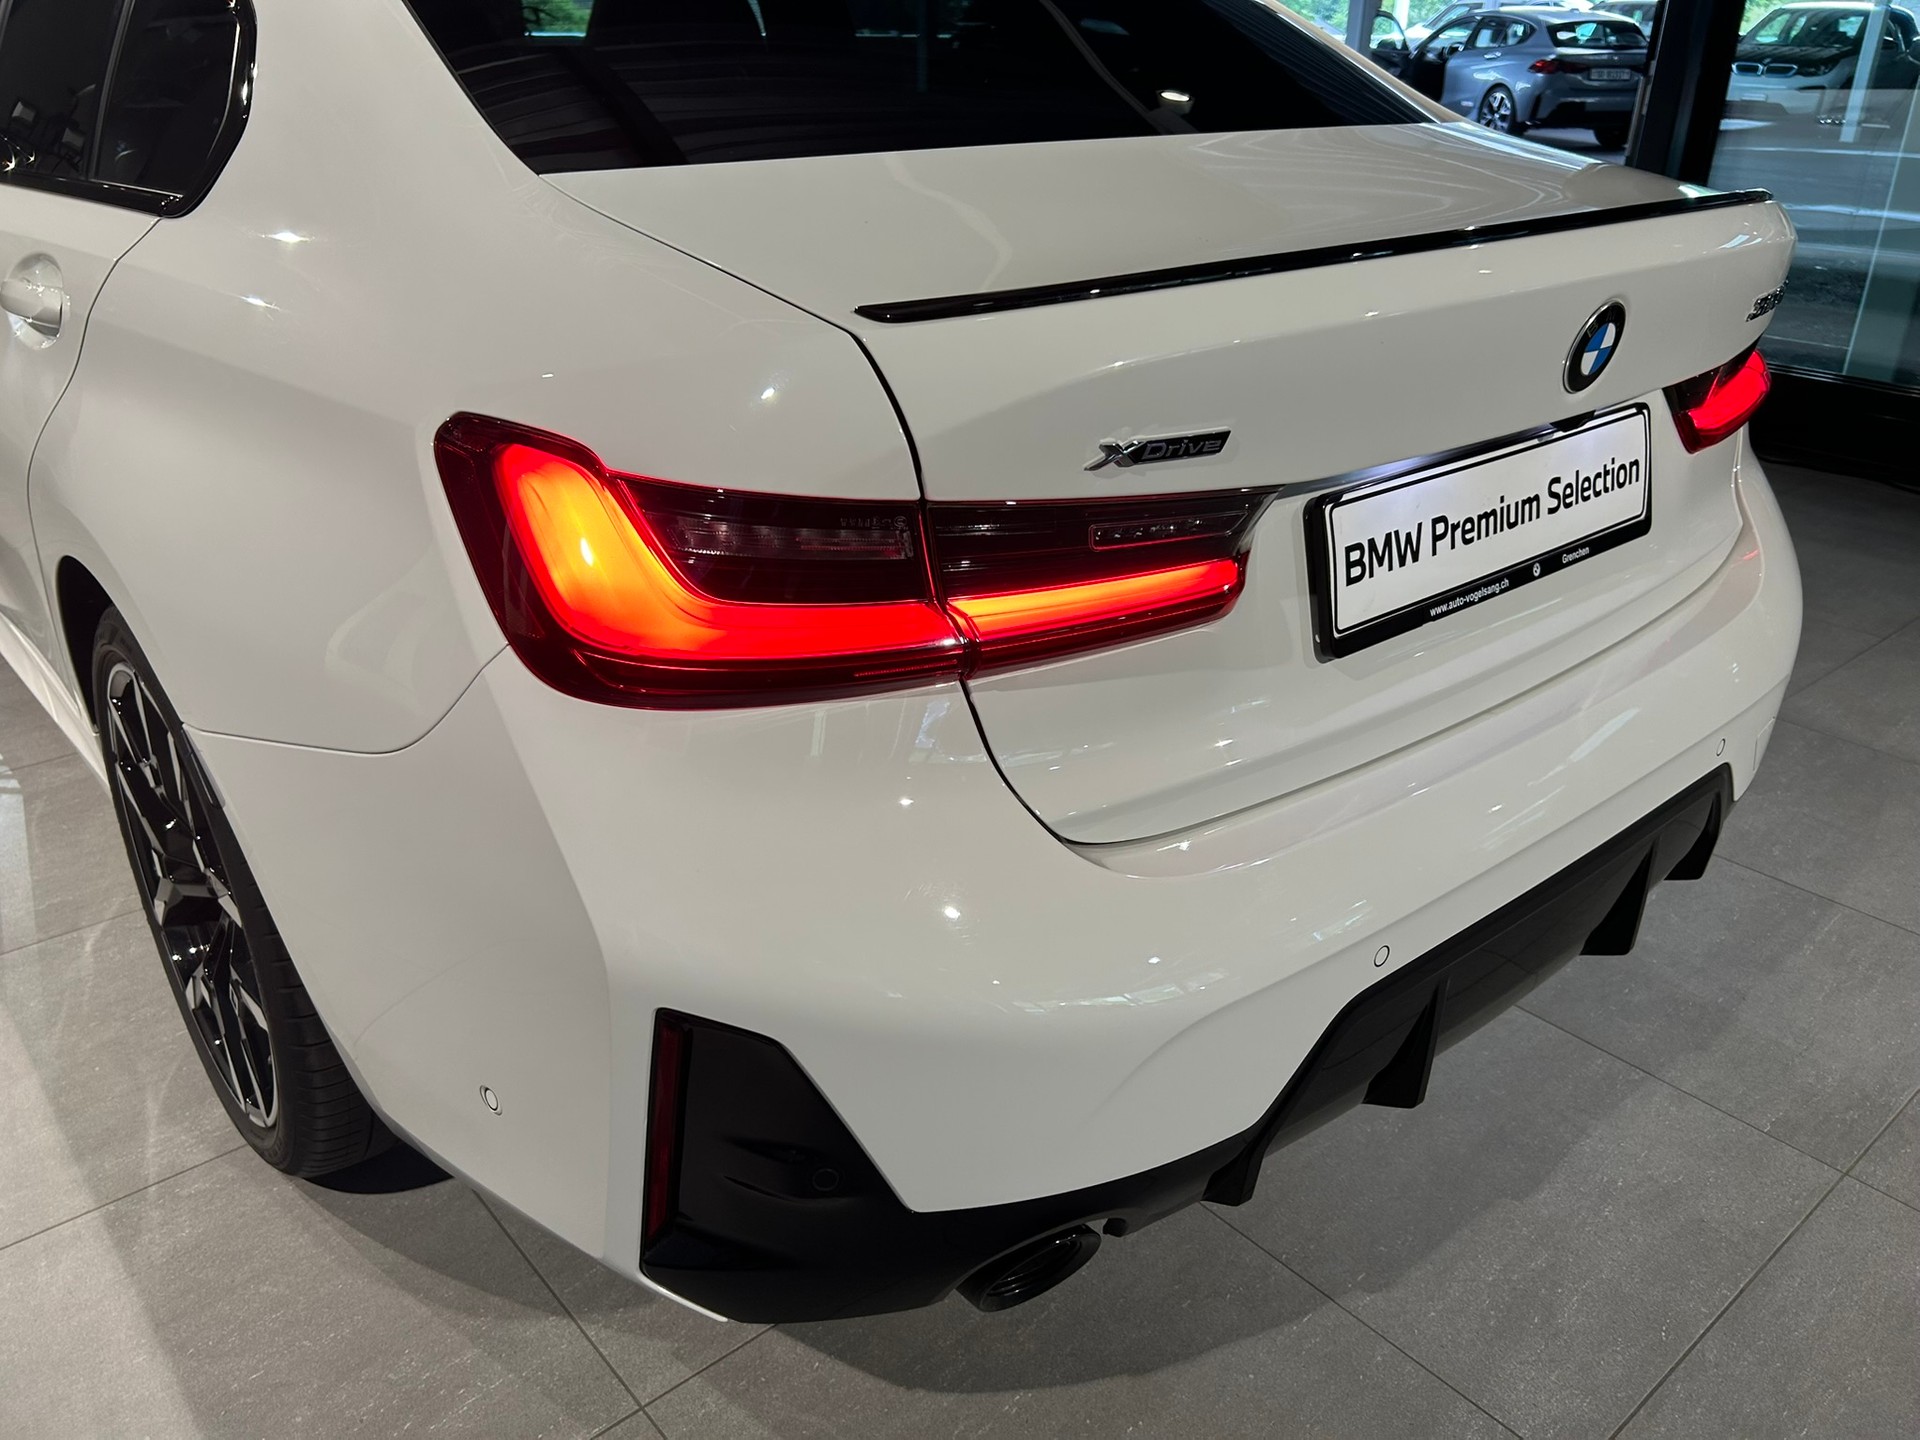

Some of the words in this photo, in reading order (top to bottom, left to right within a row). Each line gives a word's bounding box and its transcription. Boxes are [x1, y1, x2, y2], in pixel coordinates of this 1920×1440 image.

[1344, 521, 1423, 587] BMW
[1431, 493, 1541, 558] Premium
[1547, 457, 1640, 515] Selection
[1429, 578, 1510, 617] www.auto-vogelsang.ch
[1561, 547, 1590, 564] Grenchen
